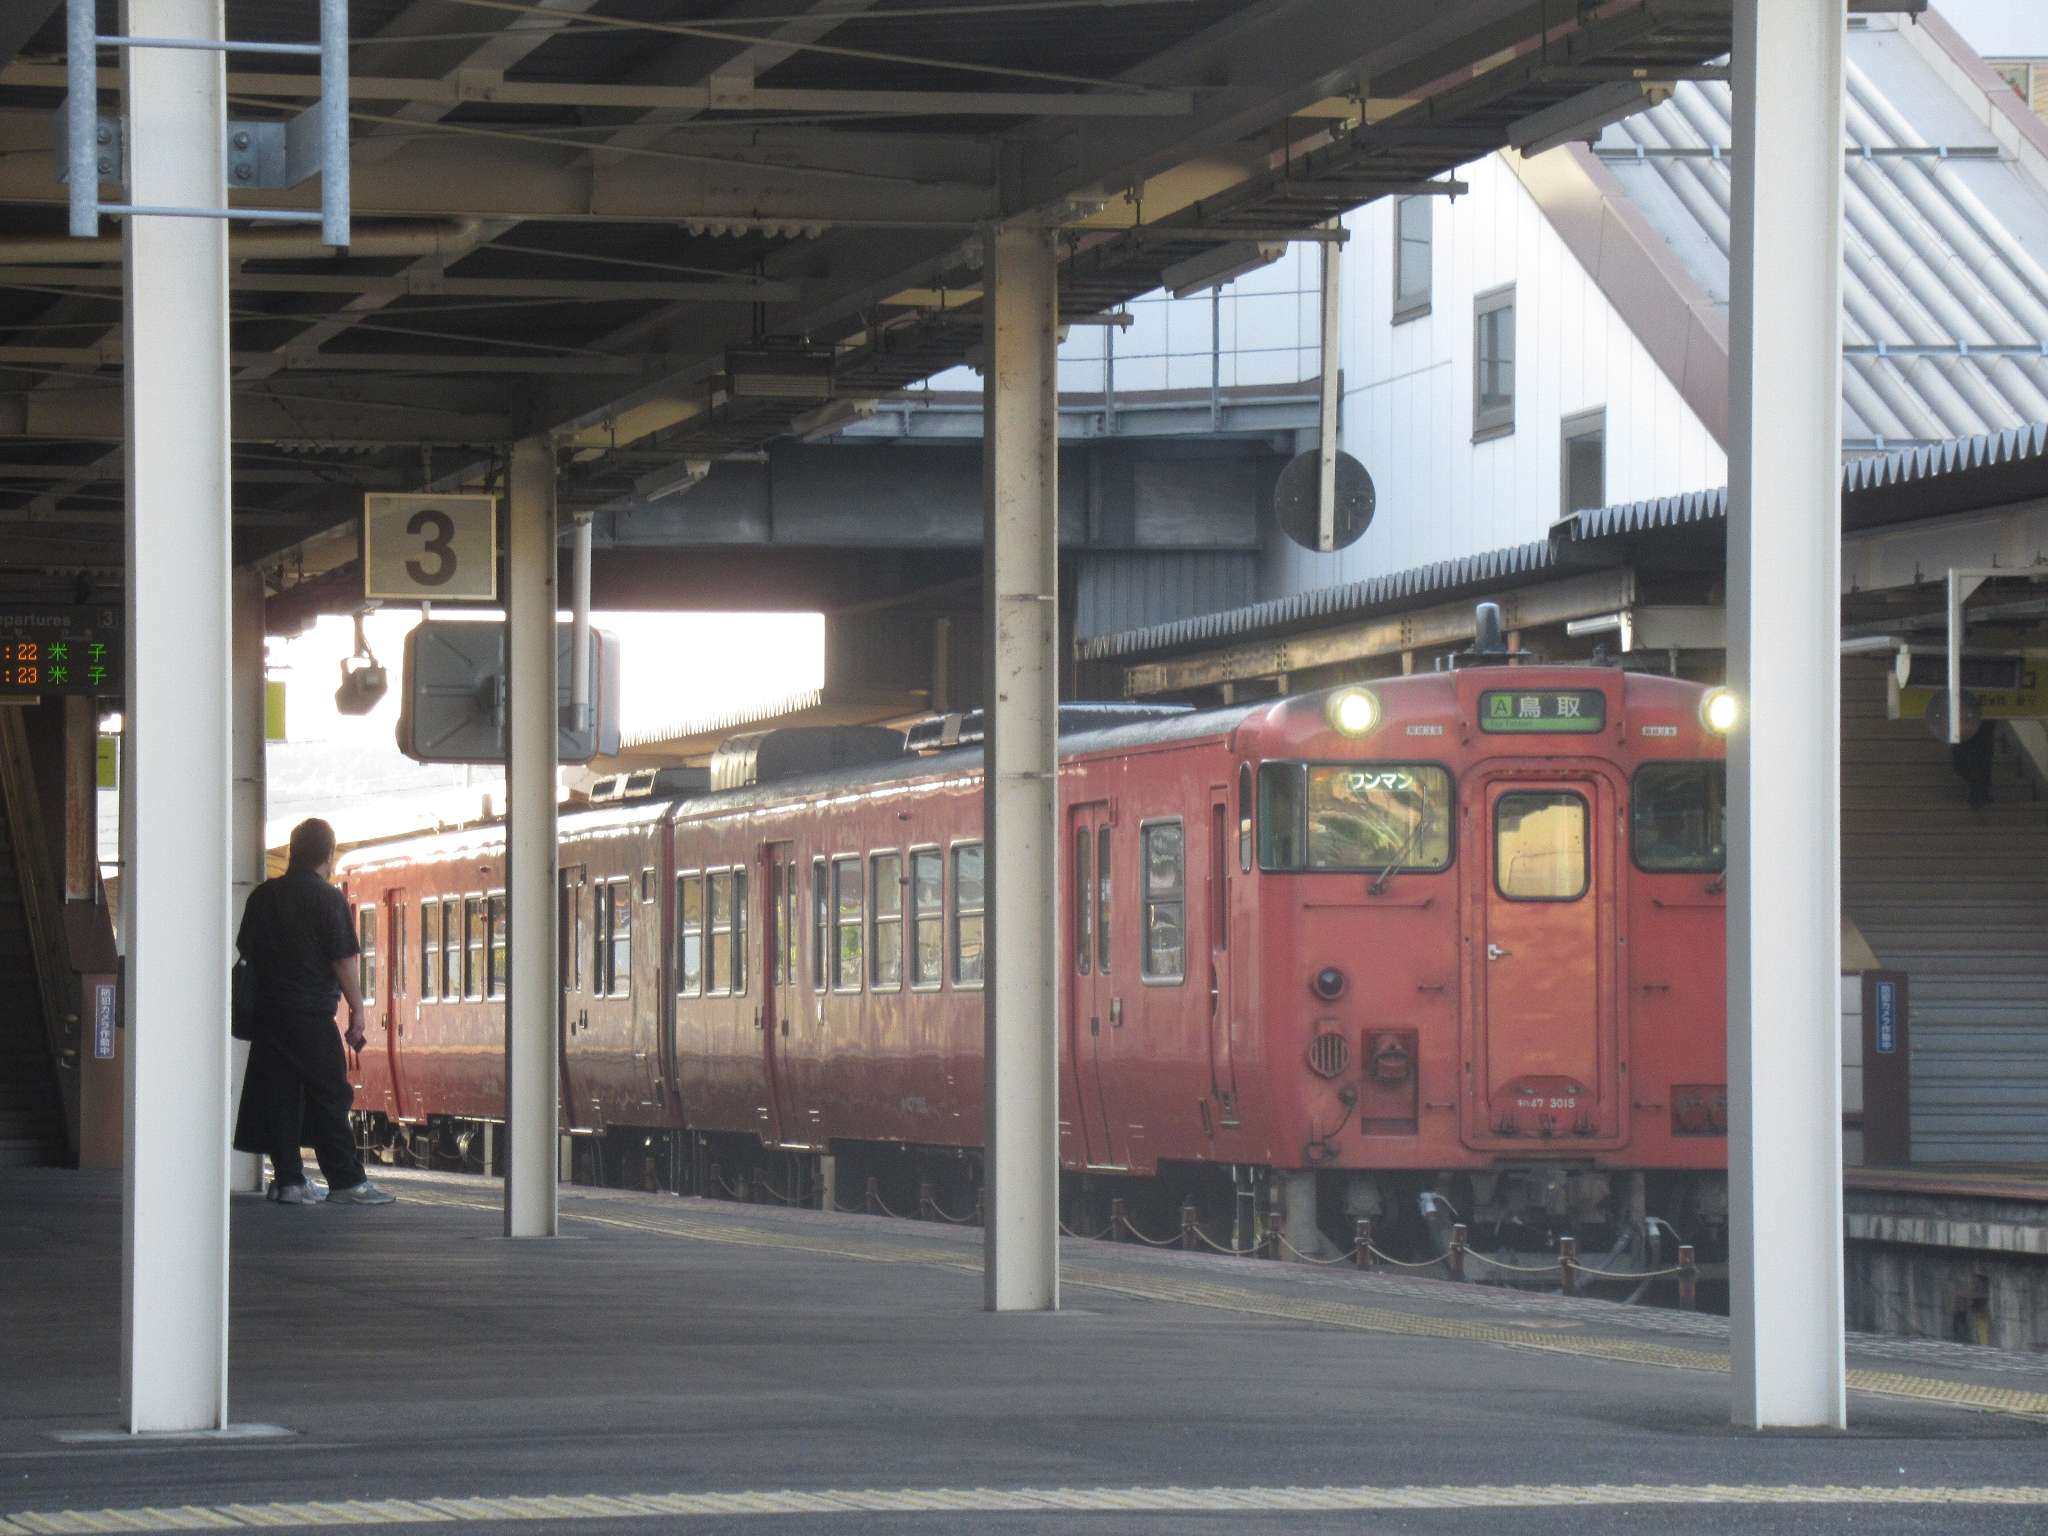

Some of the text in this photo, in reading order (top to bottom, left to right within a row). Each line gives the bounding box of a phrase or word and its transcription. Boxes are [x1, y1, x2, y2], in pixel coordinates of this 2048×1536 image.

[406, 510, 457, 586] 3
[1519, 696, 1580, 718] 鳥取
[1348, 772, 1413, 790] ワンマン
[1551, 1098, 1576, 1109] 3015
